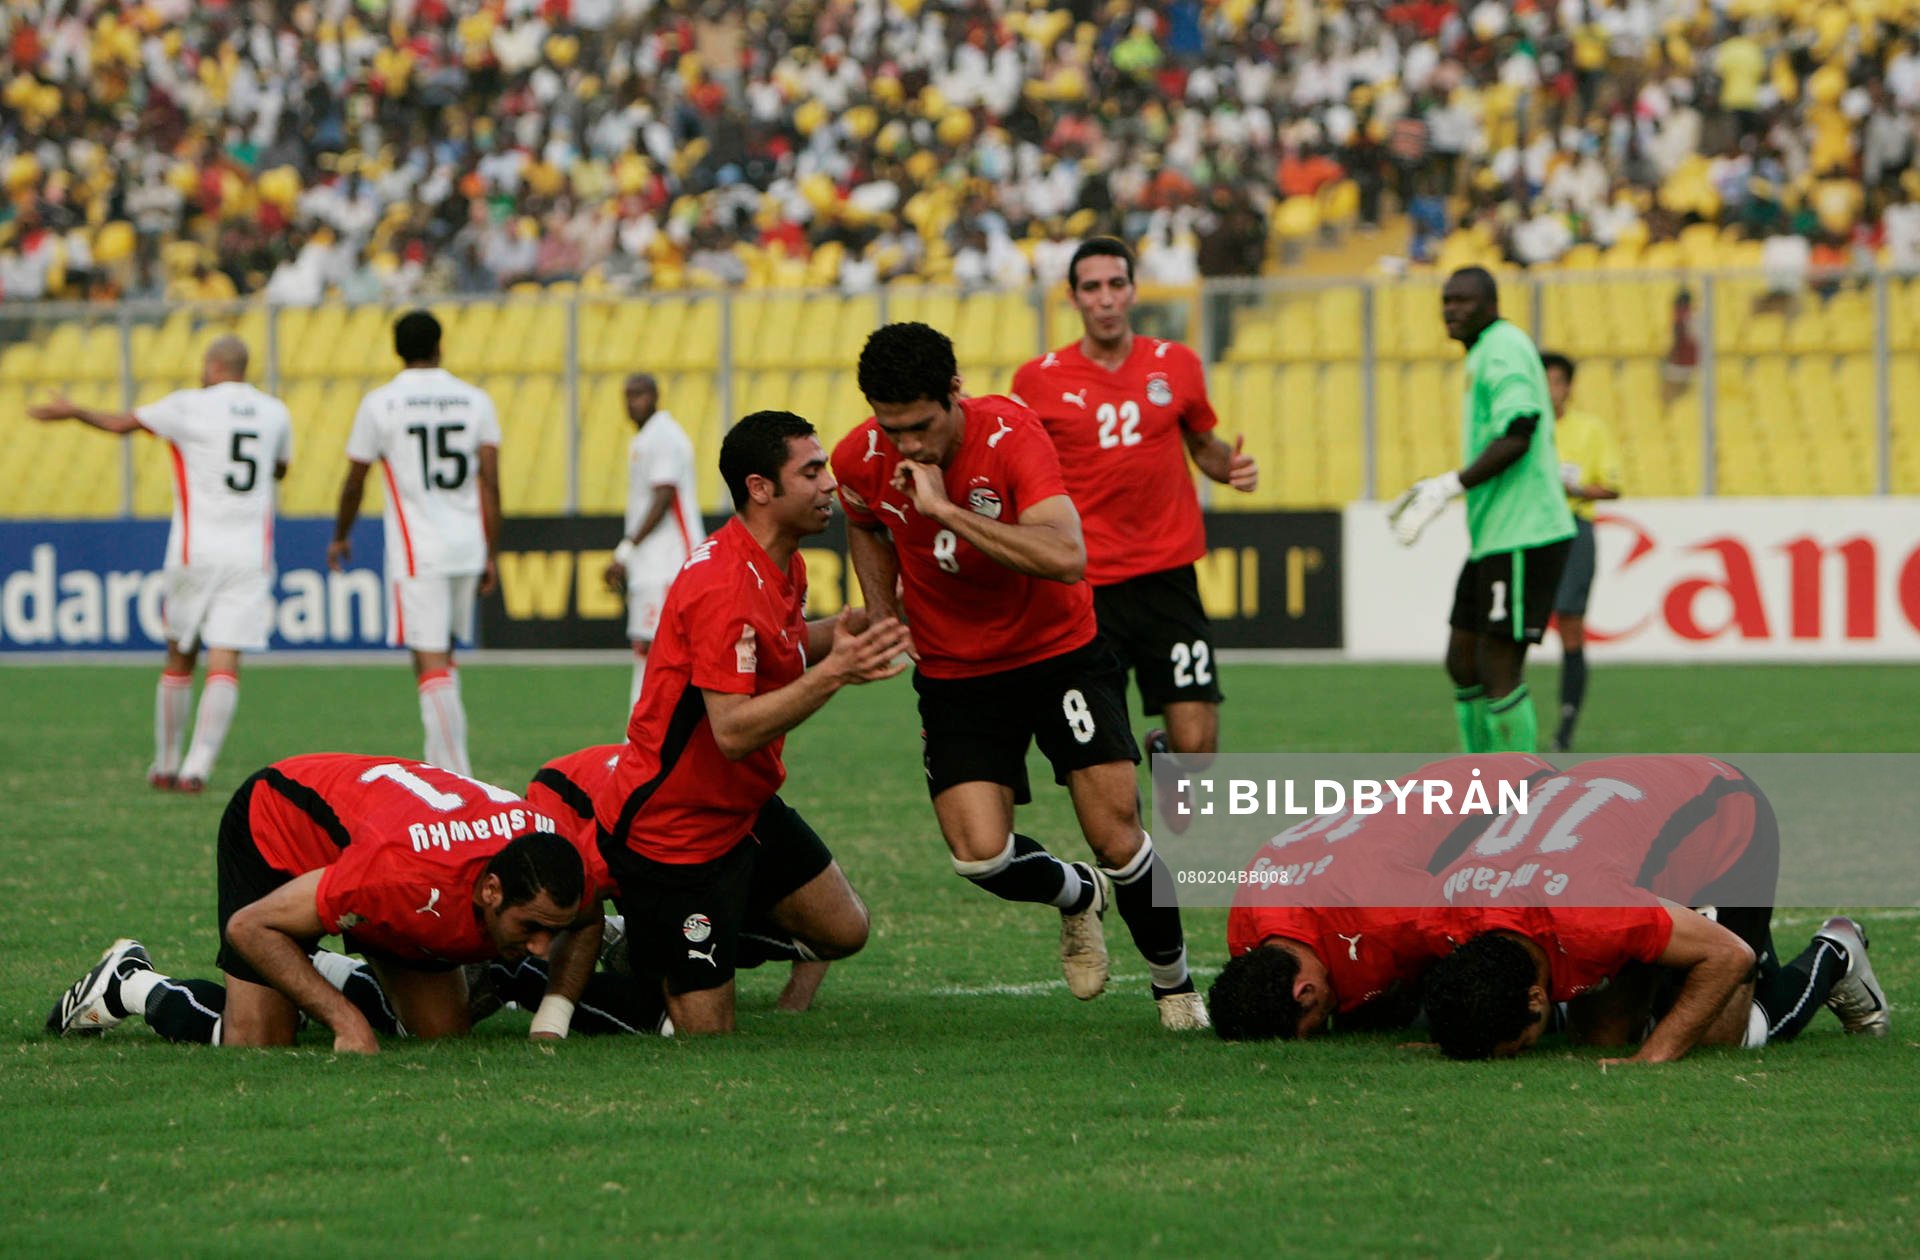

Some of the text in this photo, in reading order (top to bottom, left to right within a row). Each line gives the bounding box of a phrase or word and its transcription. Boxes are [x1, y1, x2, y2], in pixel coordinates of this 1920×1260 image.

[1096, 400, 1142, 449] 22
[225, 432, 258, 492] 5
[407, 424, 468, 491] 15
[934, 529, 959, 574] 8
[1488, 580, 1507, 621] 1
[1170, 639, 1212, 688] 22
[1062, 688, 1095, 743] 8
[408, 808, 556, 853] m.shawky
